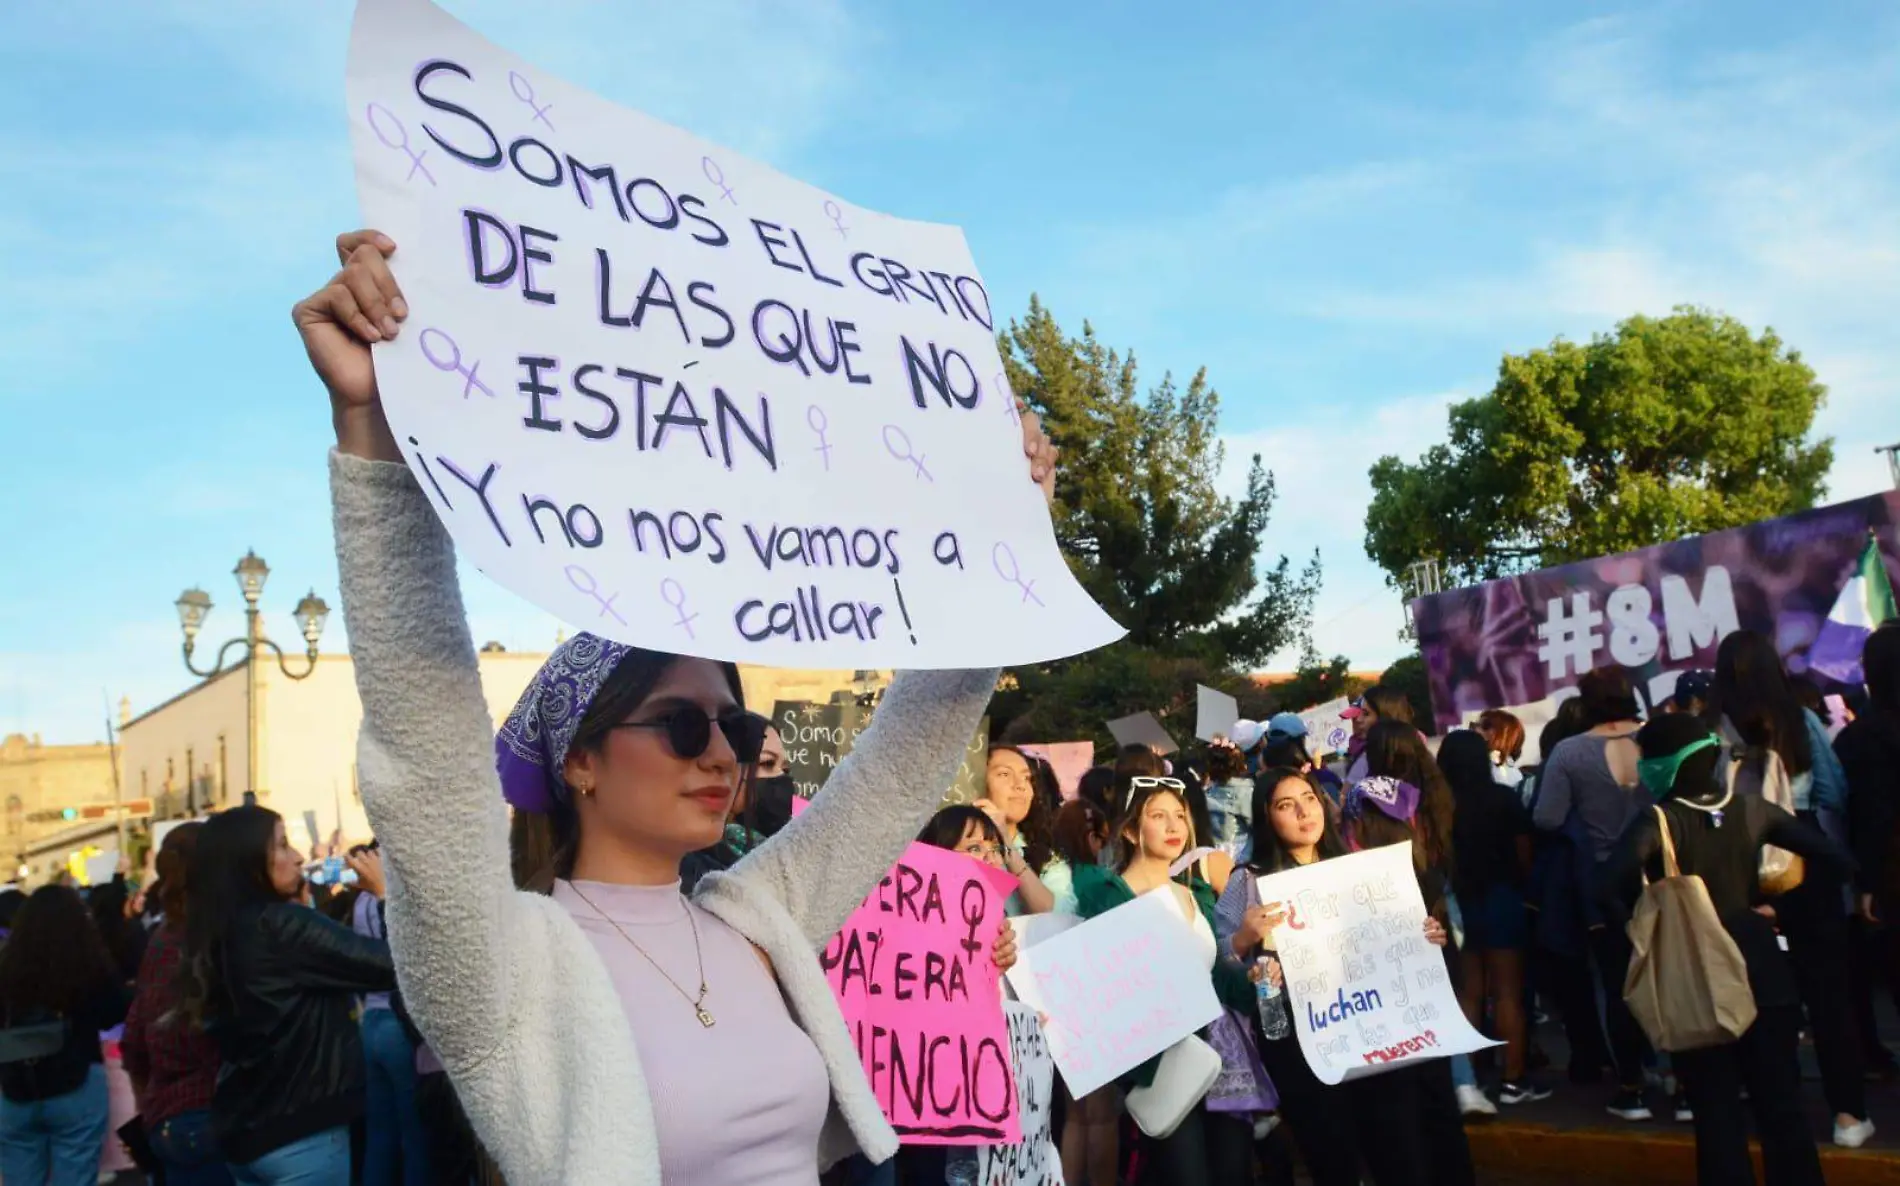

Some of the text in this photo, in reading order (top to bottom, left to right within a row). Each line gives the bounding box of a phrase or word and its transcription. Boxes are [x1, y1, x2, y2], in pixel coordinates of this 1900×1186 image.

[463, 208, 979, 410] DE LAS QUE NO
[750, 218, 844, 288] EL
[850, 252, 994, 332] GRITO
[518, 356, 778, 471] ESTÁN
[408, 436, 964, 575] ¡Y no nos vamos a
[735, 578, 917, 645] callar!
[1537, 564, 1742, 681] #8M
[895, 951, 969, 1002] ERA
[1307, 987, 1383, 1033] luchan
[1362, 1029, 1441, 1064] mueren?
